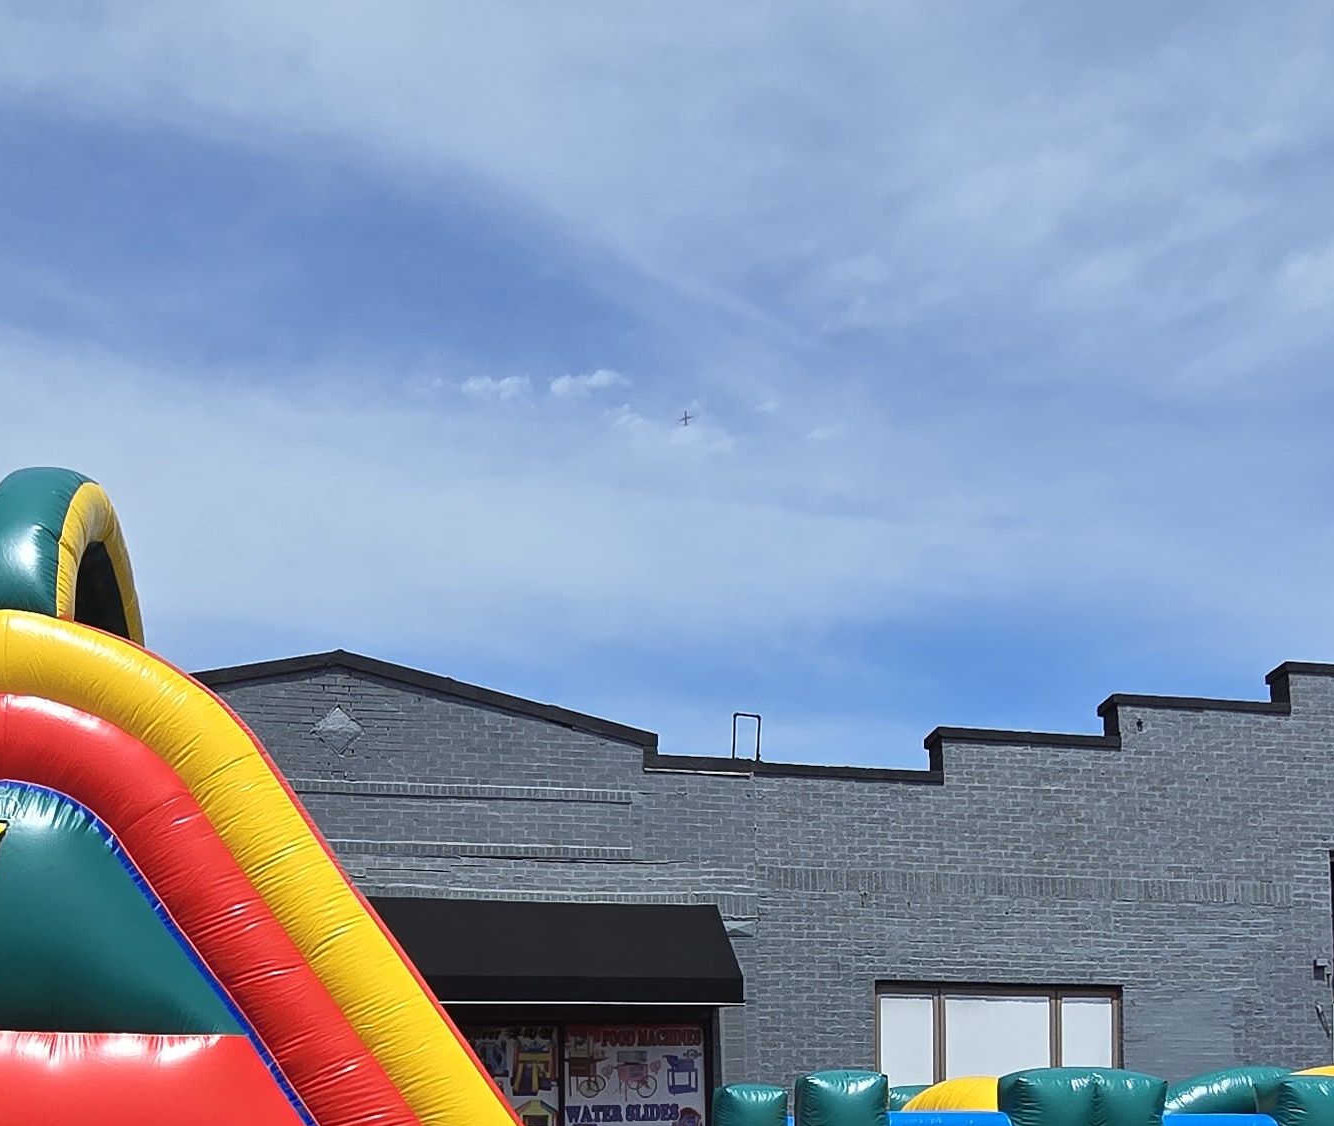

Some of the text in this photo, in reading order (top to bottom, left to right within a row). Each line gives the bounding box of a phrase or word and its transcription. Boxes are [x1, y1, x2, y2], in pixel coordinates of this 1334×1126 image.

[600, 1027, 702, 1047] FOOD MACHINES
[566, 1103, 679, 1123] WATER SLIDES
